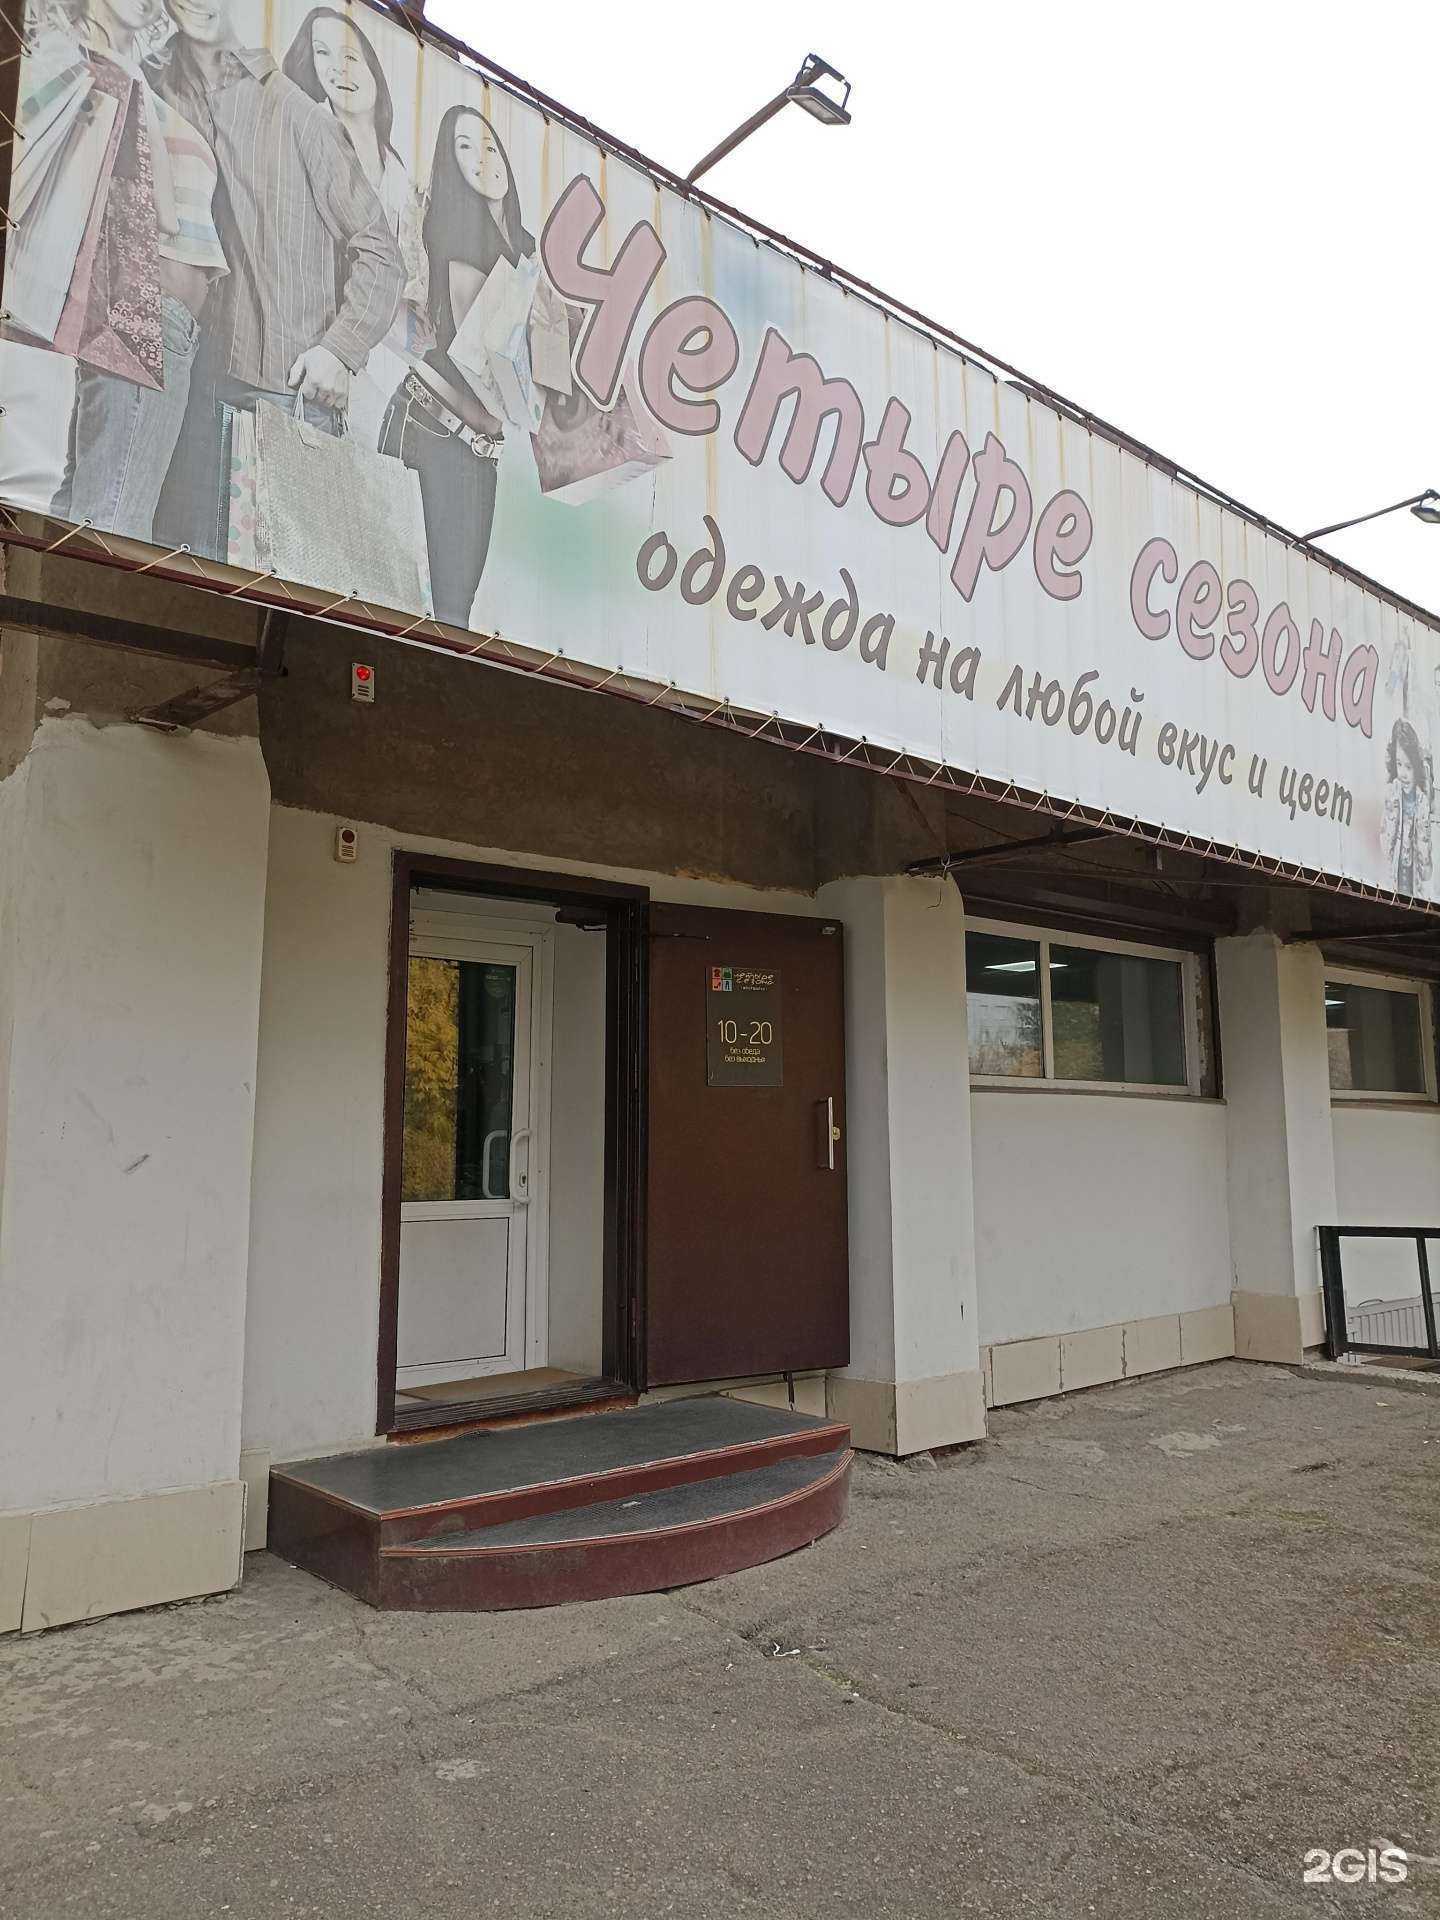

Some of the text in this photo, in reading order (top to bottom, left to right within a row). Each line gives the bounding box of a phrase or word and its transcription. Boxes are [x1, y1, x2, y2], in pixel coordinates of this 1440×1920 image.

[541, 173, 1379, 738] Четыре сезона
[637, 515, 1352, 826] одежда на любой вкус и цвет
[742, 1048, 761, 1056] обеда
